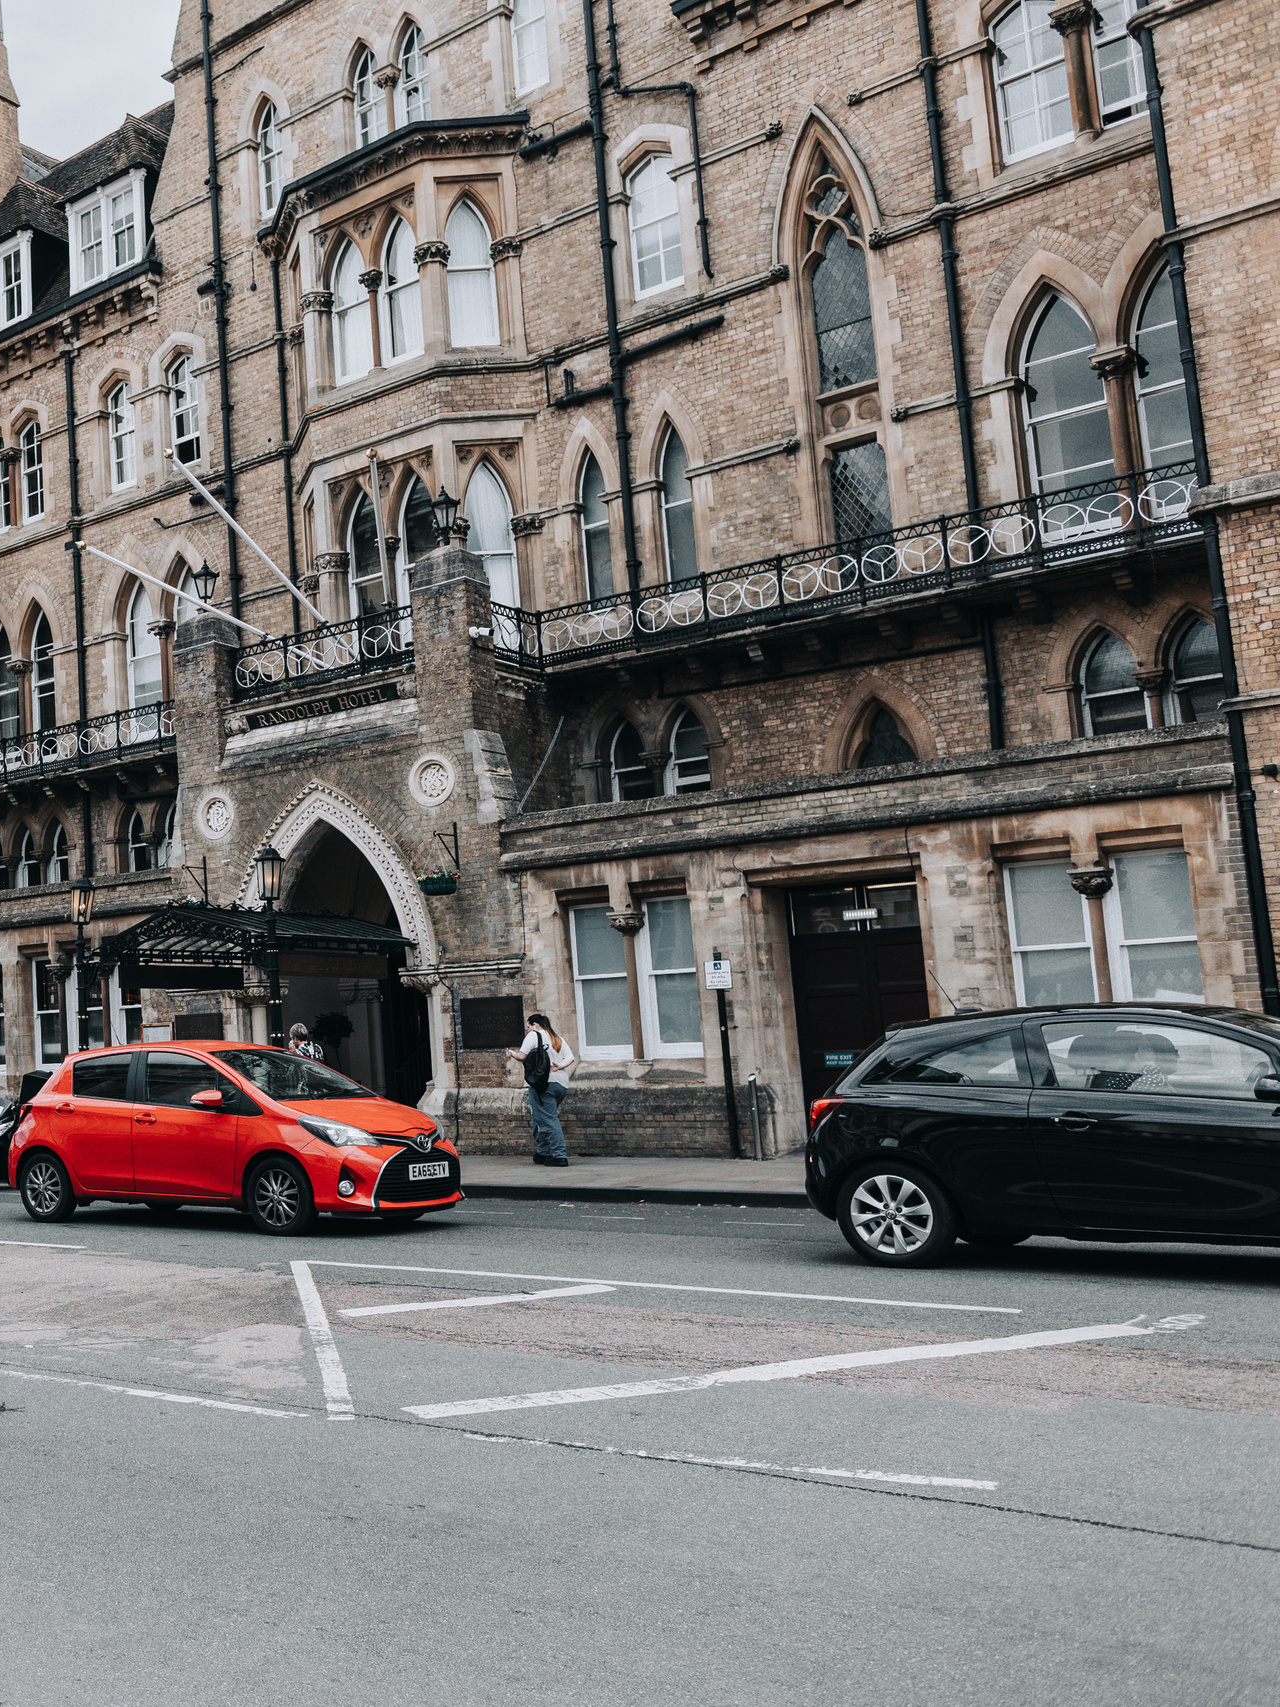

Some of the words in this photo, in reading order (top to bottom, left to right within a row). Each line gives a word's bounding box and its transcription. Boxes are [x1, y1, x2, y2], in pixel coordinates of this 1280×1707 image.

[256, 700, 332, 727] RANDOLPH
[338, 688, 387, 710] HOTEL
[468, 1015, 516, 1025] RANDOLPH
[479, 1024, 507, 1032] HOTEL
